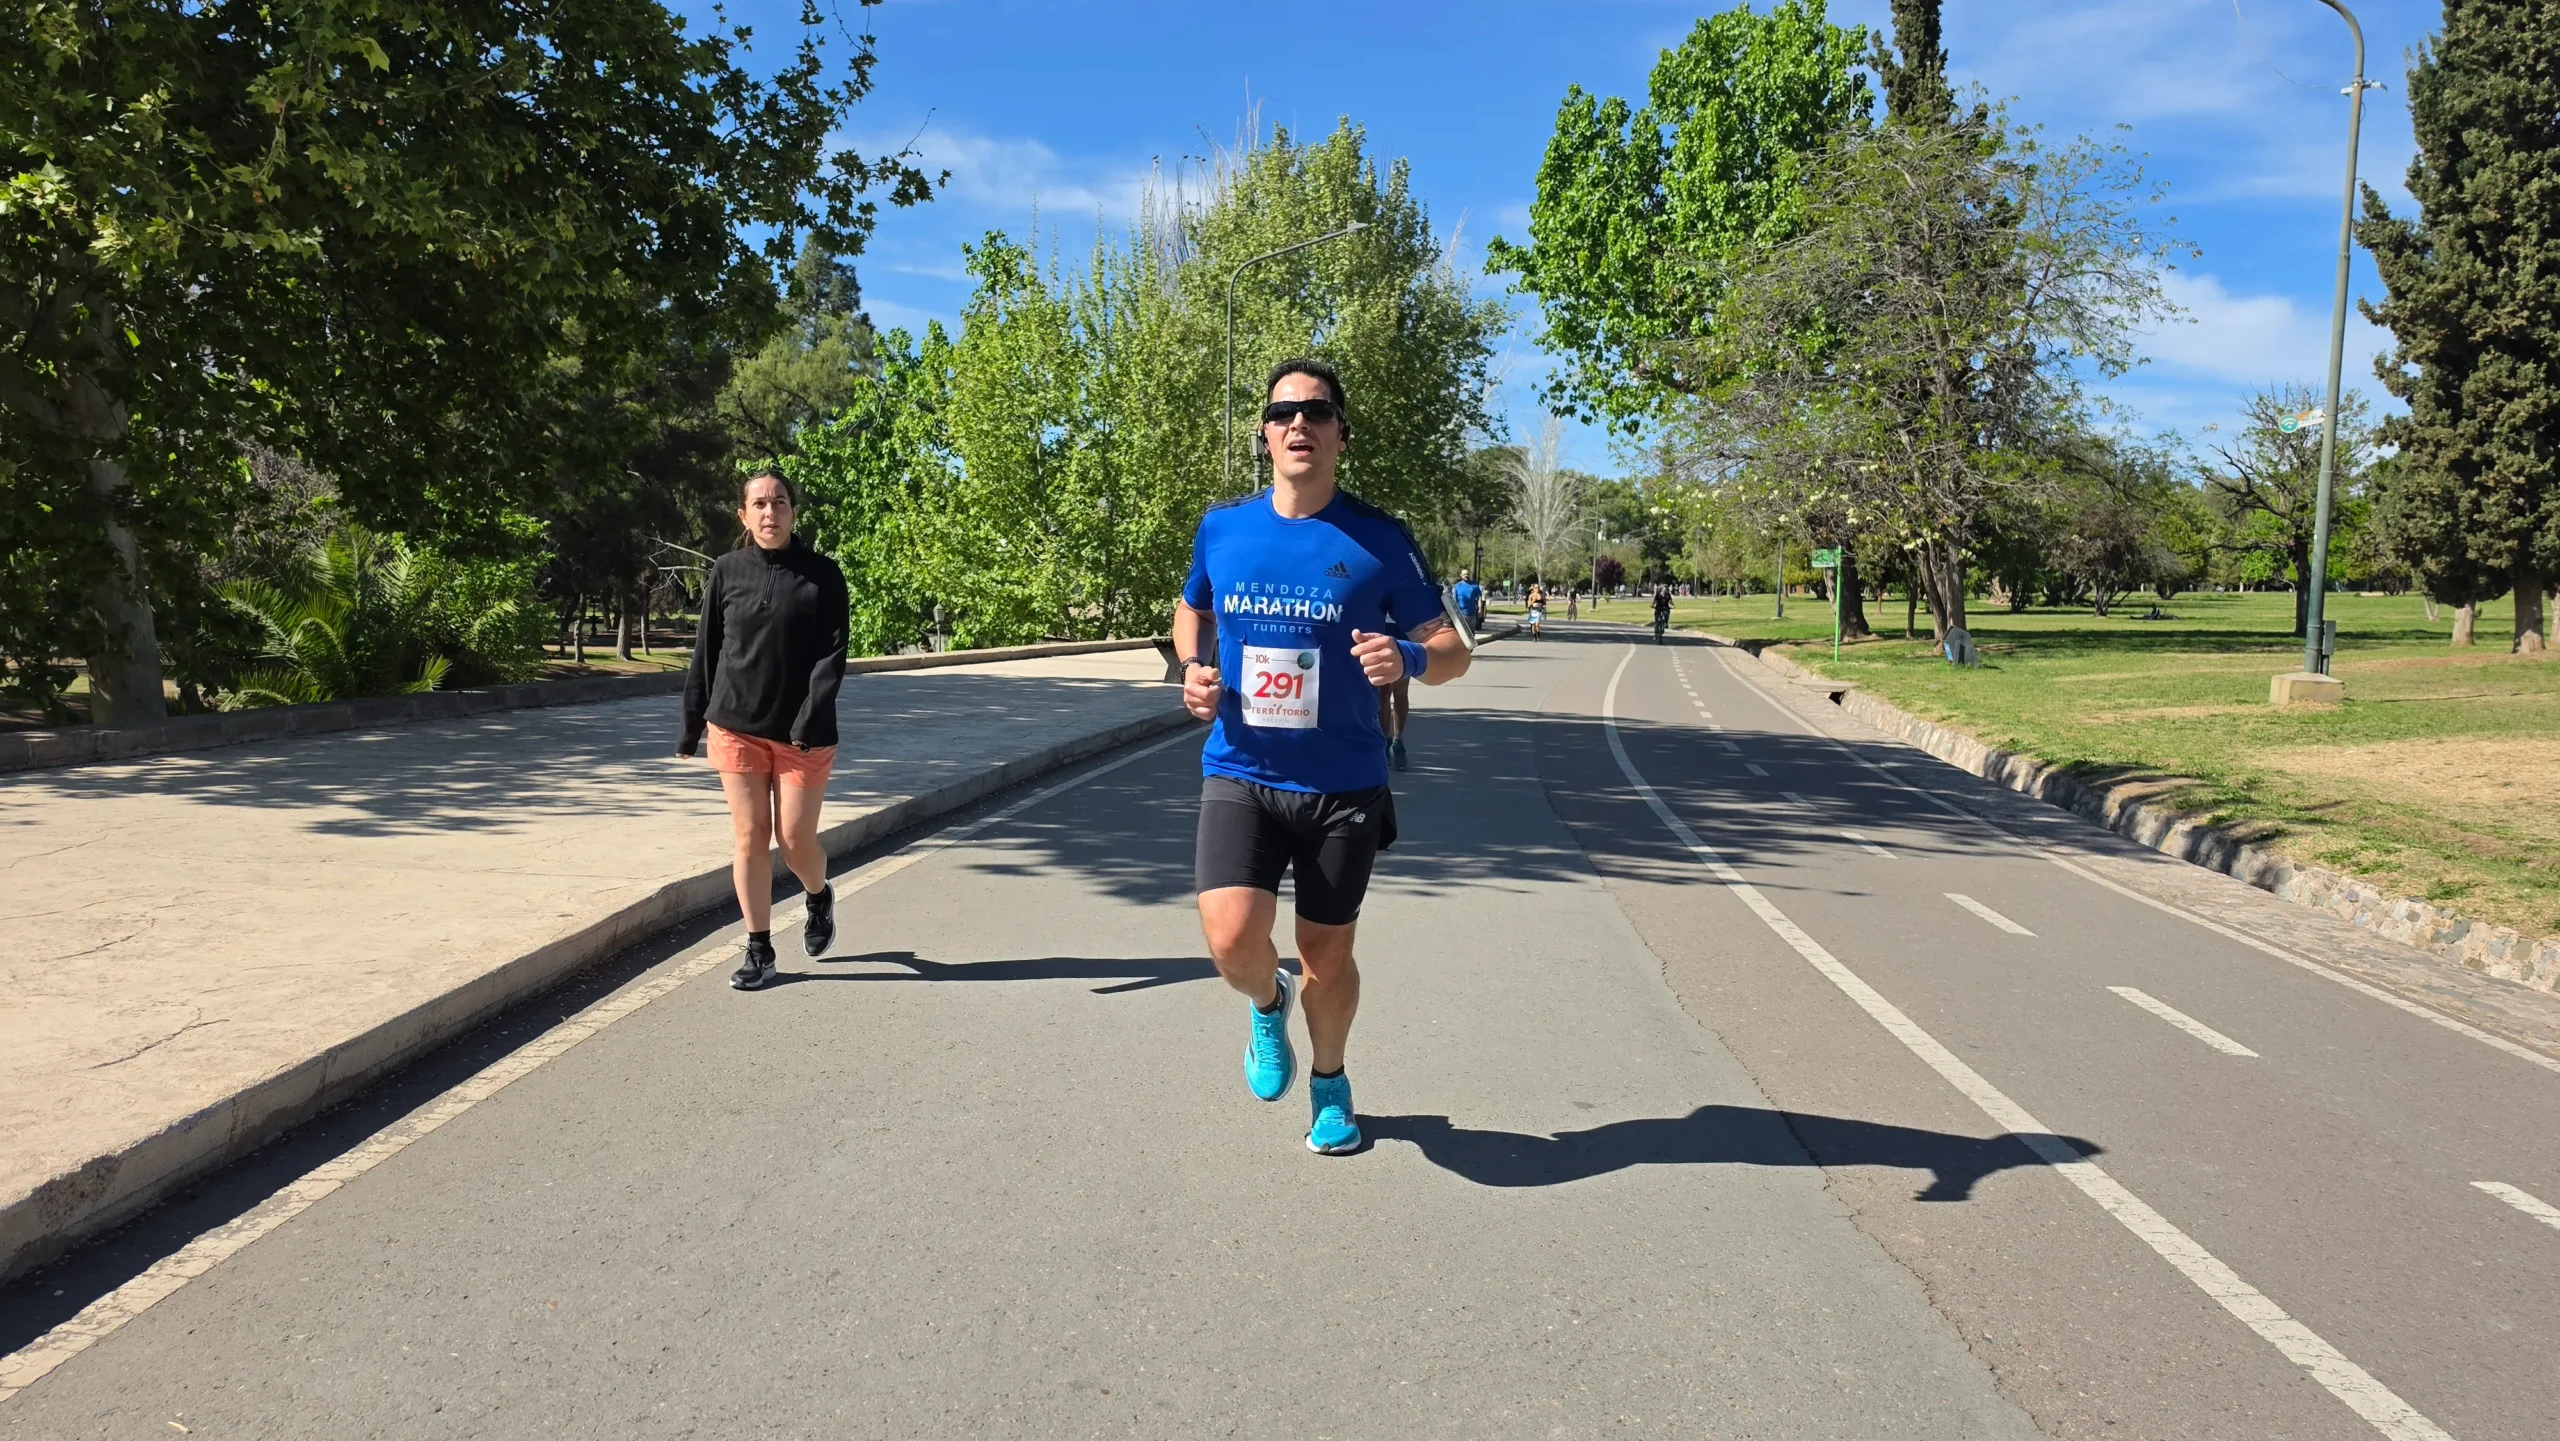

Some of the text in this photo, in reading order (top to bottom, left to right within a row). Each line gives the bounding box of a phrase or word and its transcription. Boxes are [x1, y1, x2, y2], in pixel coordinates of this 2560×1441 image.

[1323, 570, 1351, 580] adidas
[1235, 582, 1333, 600] MENDOZA
[1223, 593, 1344, 623] MARATHON
[1253, 623, 1312, 634] runners
[1255, 654, 1270, 664] 10k
[1252, 671, 1304, 700] 291
[1251, 703, 1310, 717] TERRITORIO
